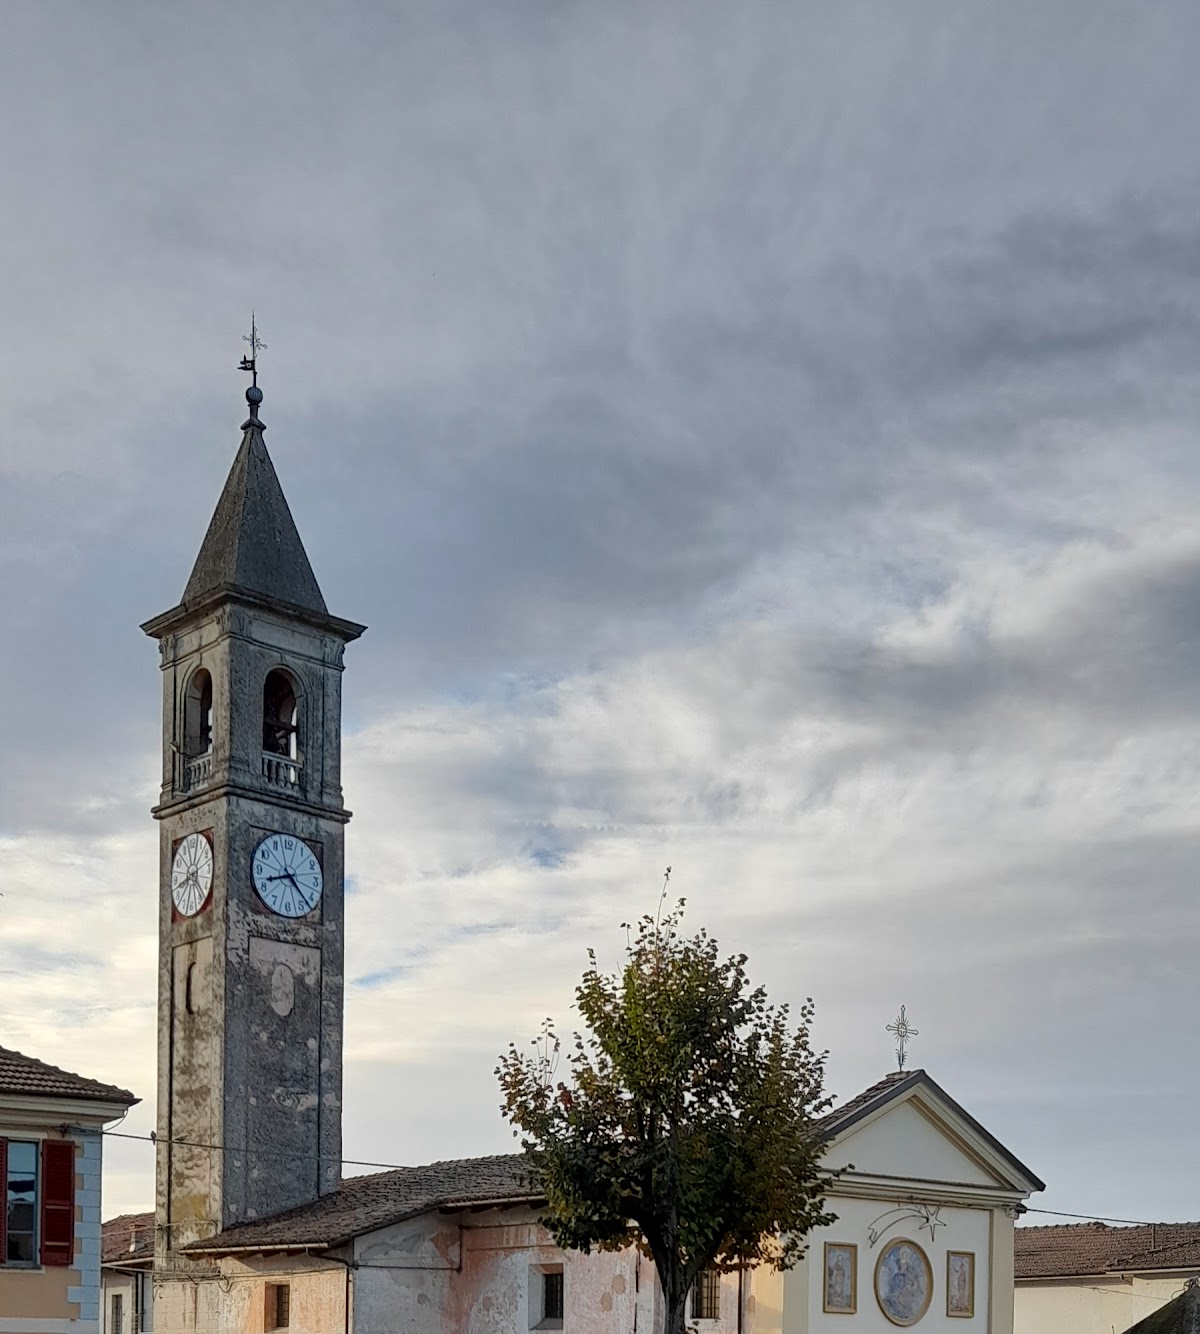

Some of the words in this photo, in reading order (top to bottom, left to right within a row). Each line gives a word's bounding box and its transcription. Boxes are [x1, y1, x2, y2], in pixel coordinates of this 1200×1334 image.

[273, 840, 278, 851] 11
[284, 838, 293, 850] 12
[262, 849, 270, 860] 10
[256, 864, 262, 875] 9
[309, 860, 315, 870] 2
[261, 882, 266, 892] 8
[313, 876, 318, 887] 3
[272, 894, 278, 905] 7
[285, 902, 291, 912] 6
[298, 900, 304, 911] 5
